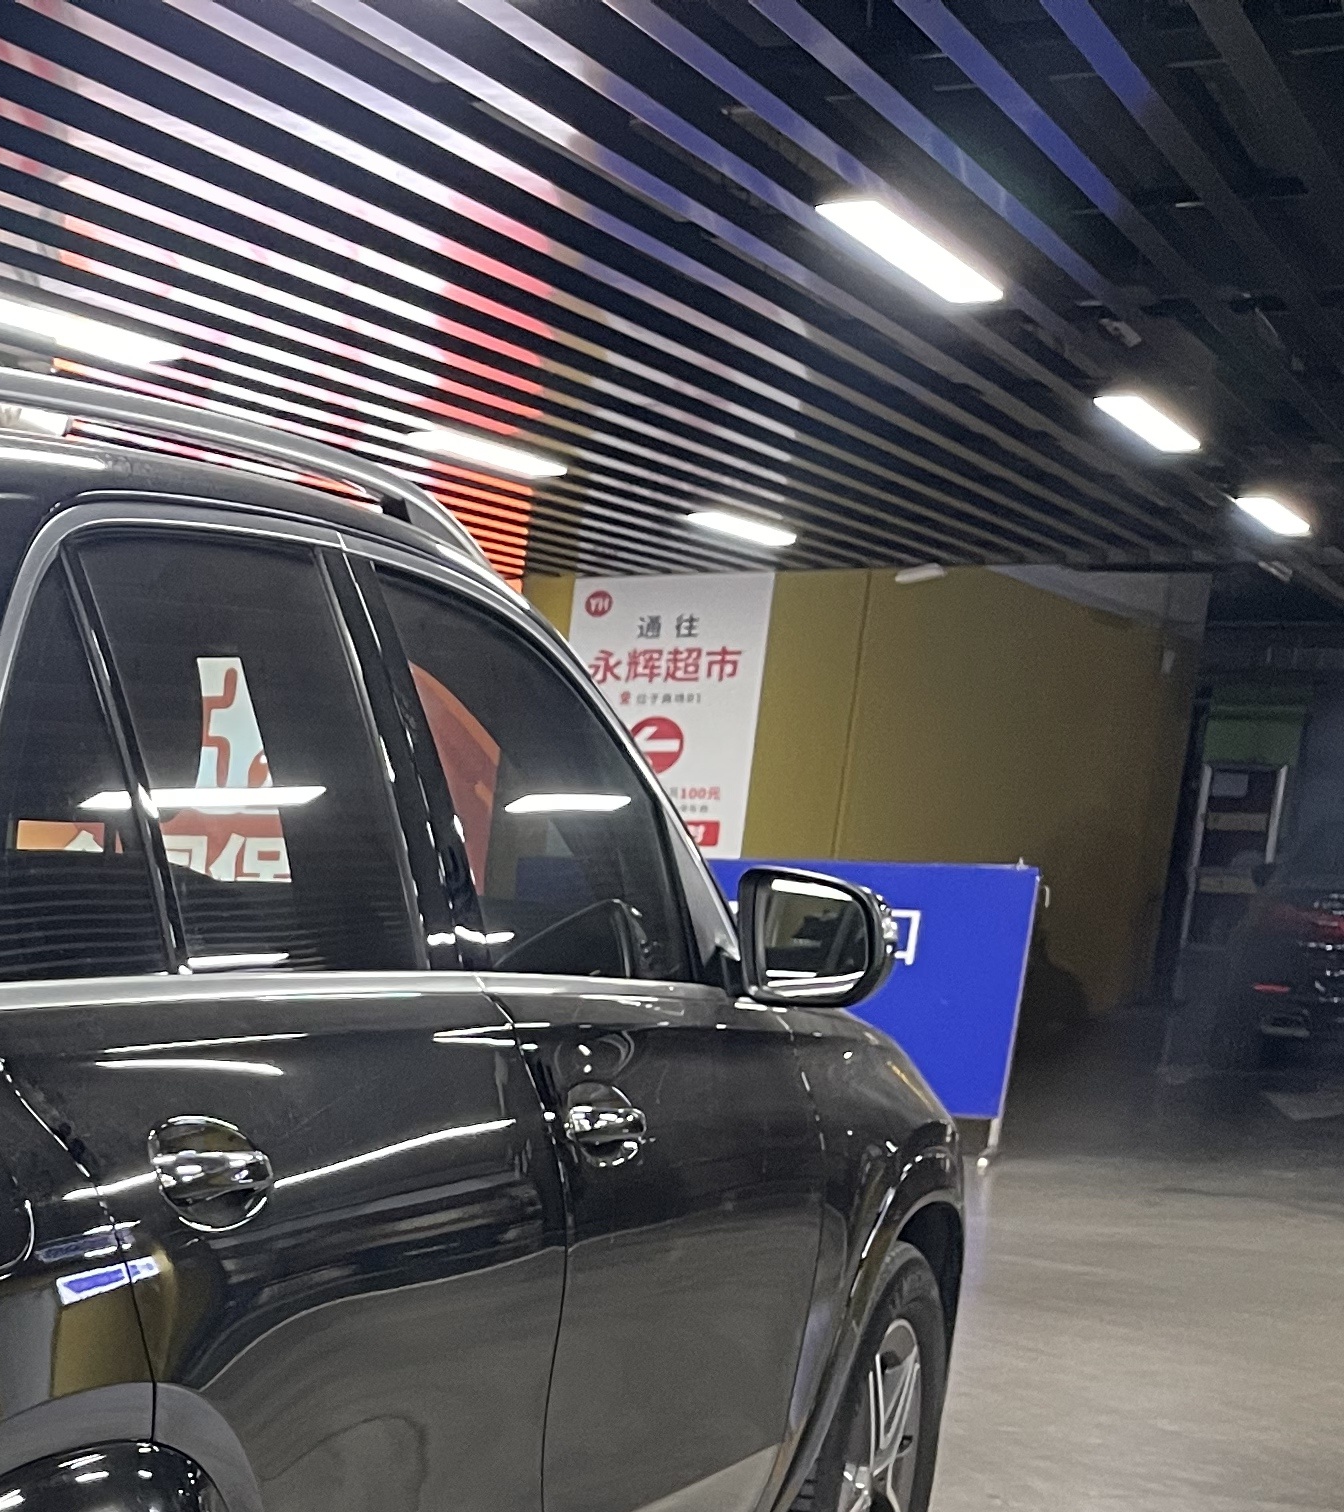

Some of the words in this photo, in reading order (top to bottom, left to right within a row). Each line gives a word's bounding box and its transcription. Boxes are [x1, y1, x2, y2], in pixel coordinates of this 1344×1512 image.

[637, 613, 700, 638] 通往
[588, 646, 742, 685] 永辉超市
